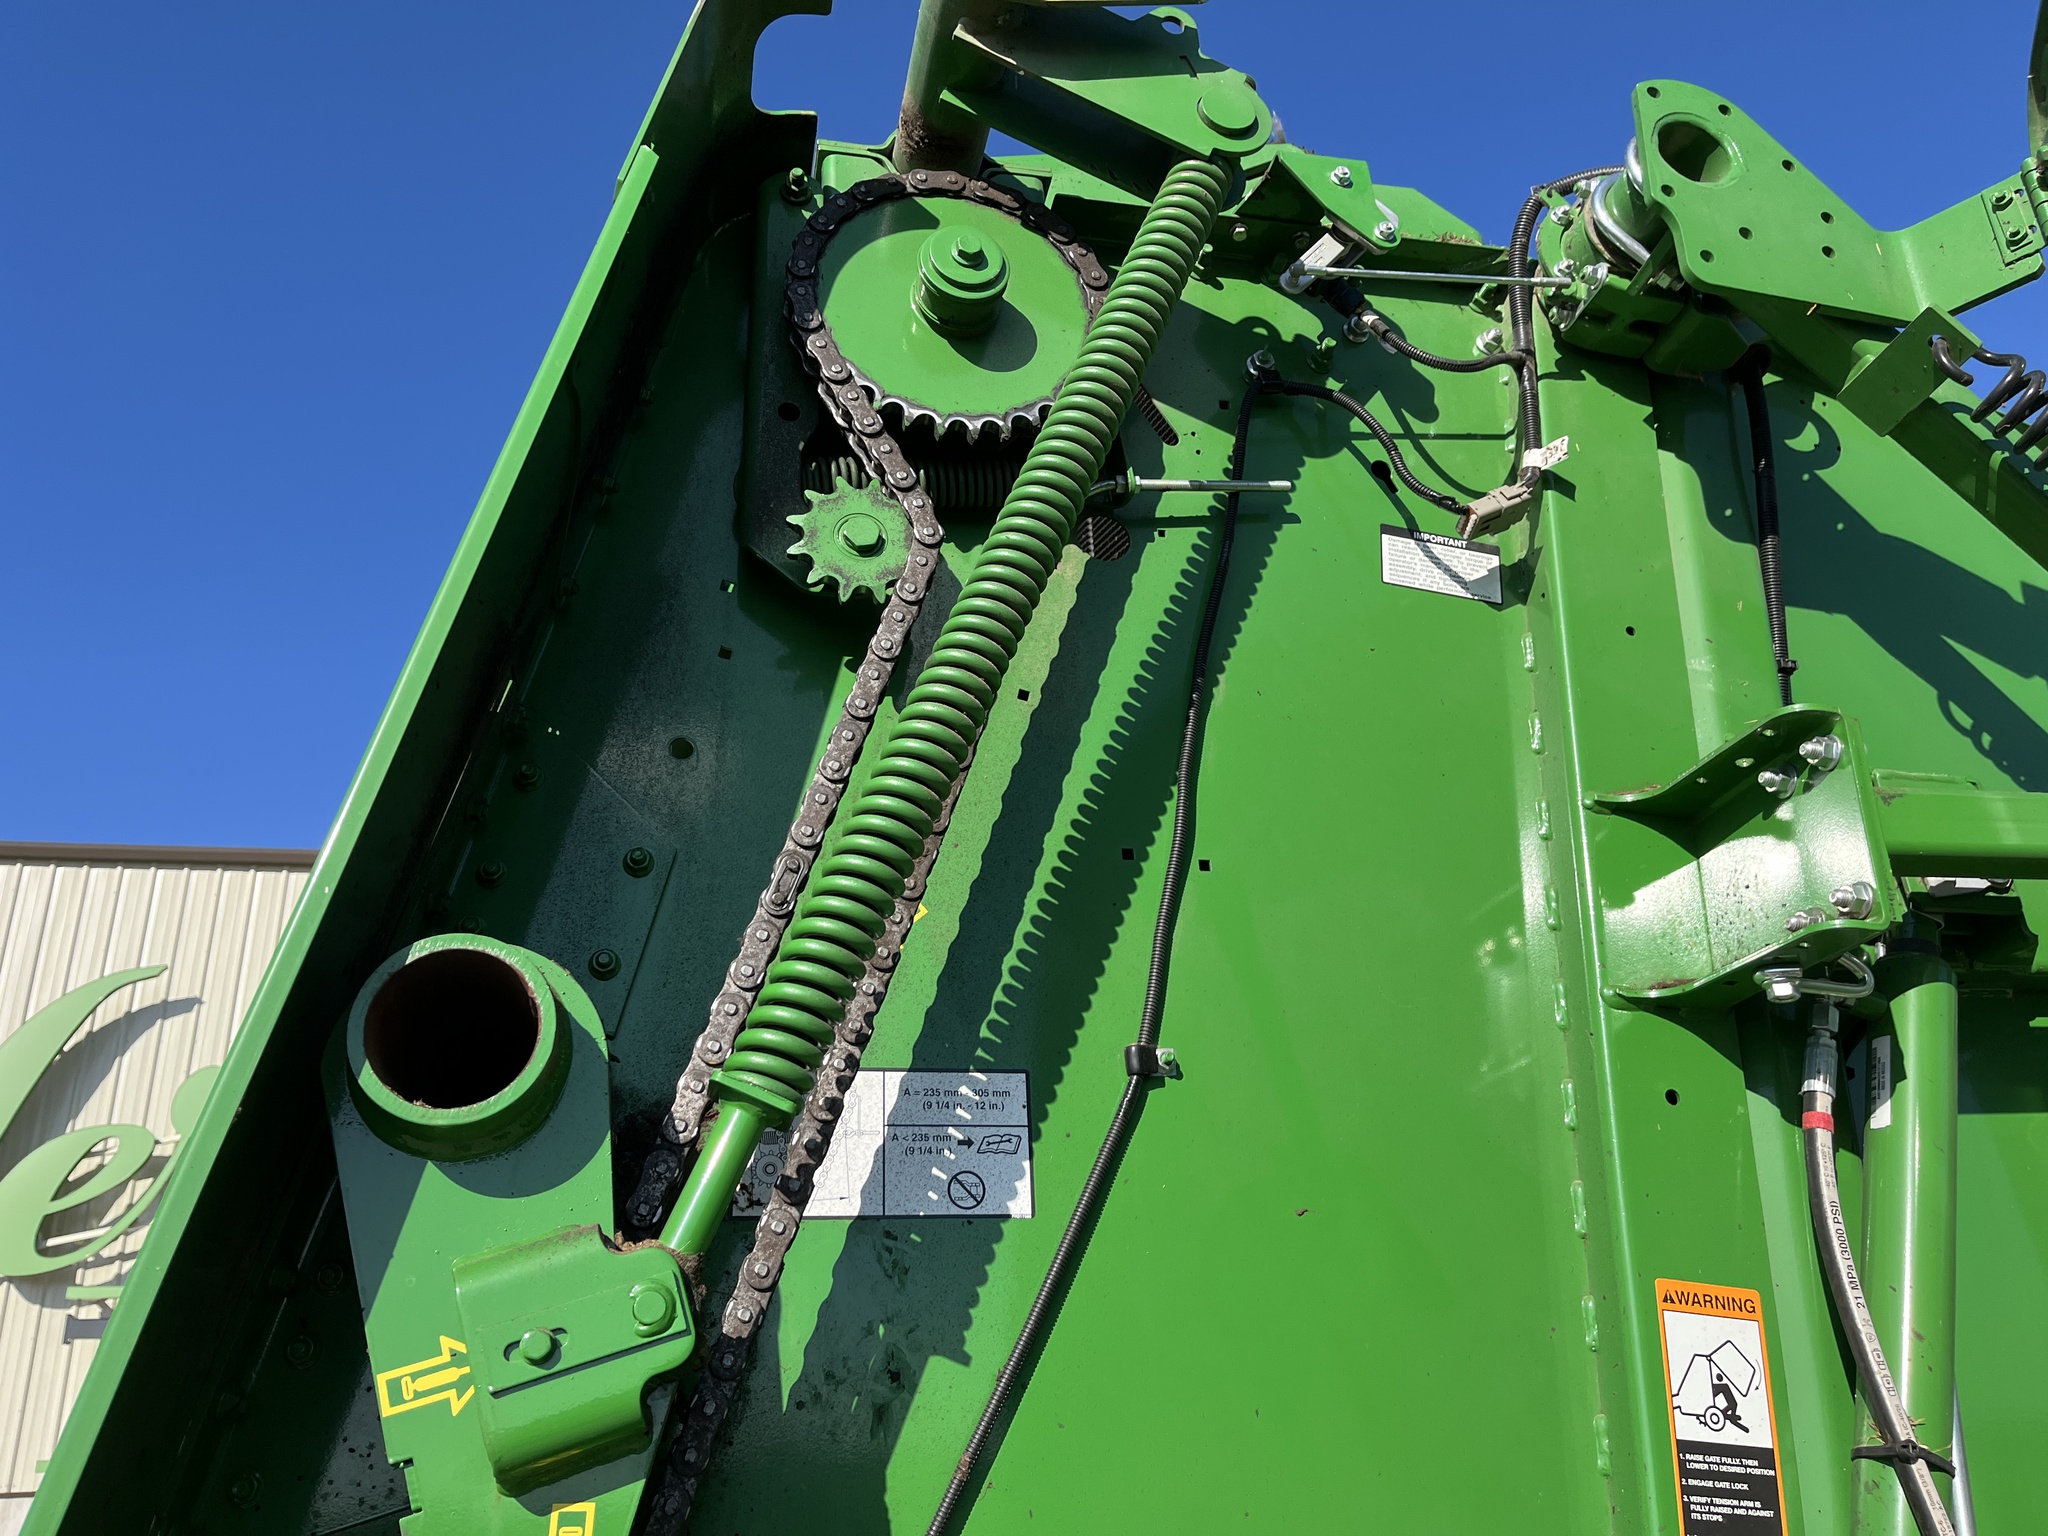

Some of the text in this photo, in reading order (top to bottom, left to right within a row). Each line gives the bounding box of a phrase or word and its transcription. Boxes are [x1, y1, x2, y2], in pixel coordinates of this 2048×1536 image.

[1414, 532, 1468, 548] IMPORTANT
[904, 1088, 910, 1097] A
[923, 1088, 940, 1097] 235
[972, 1089, 989, 1098] 305
[992, 1090, 1010, 1098] mm
[922, 1101, 932, 1110] (9
[936, 1102, 950, 1110] 1/4
[974, 1102, 986, 1110] 12
[988, 1102, 1005, 1112] in.)
[891, 1134, 900, 1142] A
[911, 1134, 930, 1142] 235
[904, 1146, 915, 1156] (9
[918, 1146, 933, 1155] 1/4
[1830, 1200, 1842, 1224] PSI)
[1836, 1228, 1852, 1260] (3000
[1846, 1264, 1860, 1290] MPa
[1674, 1290, 1756, 1314] WARNING
[1854, 1296, 1866, 1309] 21
[1705, 1455, 1720, 1463] GATE
[1686, 1462, 1709, 1470] LOWER
[1719, 1465, 1745, 1473] DESIRED
[1747, 1467, 1775, 1476] POSITION
[1688, 1479, 1713, 1487] ENGAGE
[1714, 1481, 1730, 1489] GATE
[1712, 1497, 1739, 1506] TENSION
[1710, 1506, 1732, 1514] RAISED
[1748, 1510, 1774, 1518] AGAINST
[1702, 1514, 1723, 1522] STOPS
